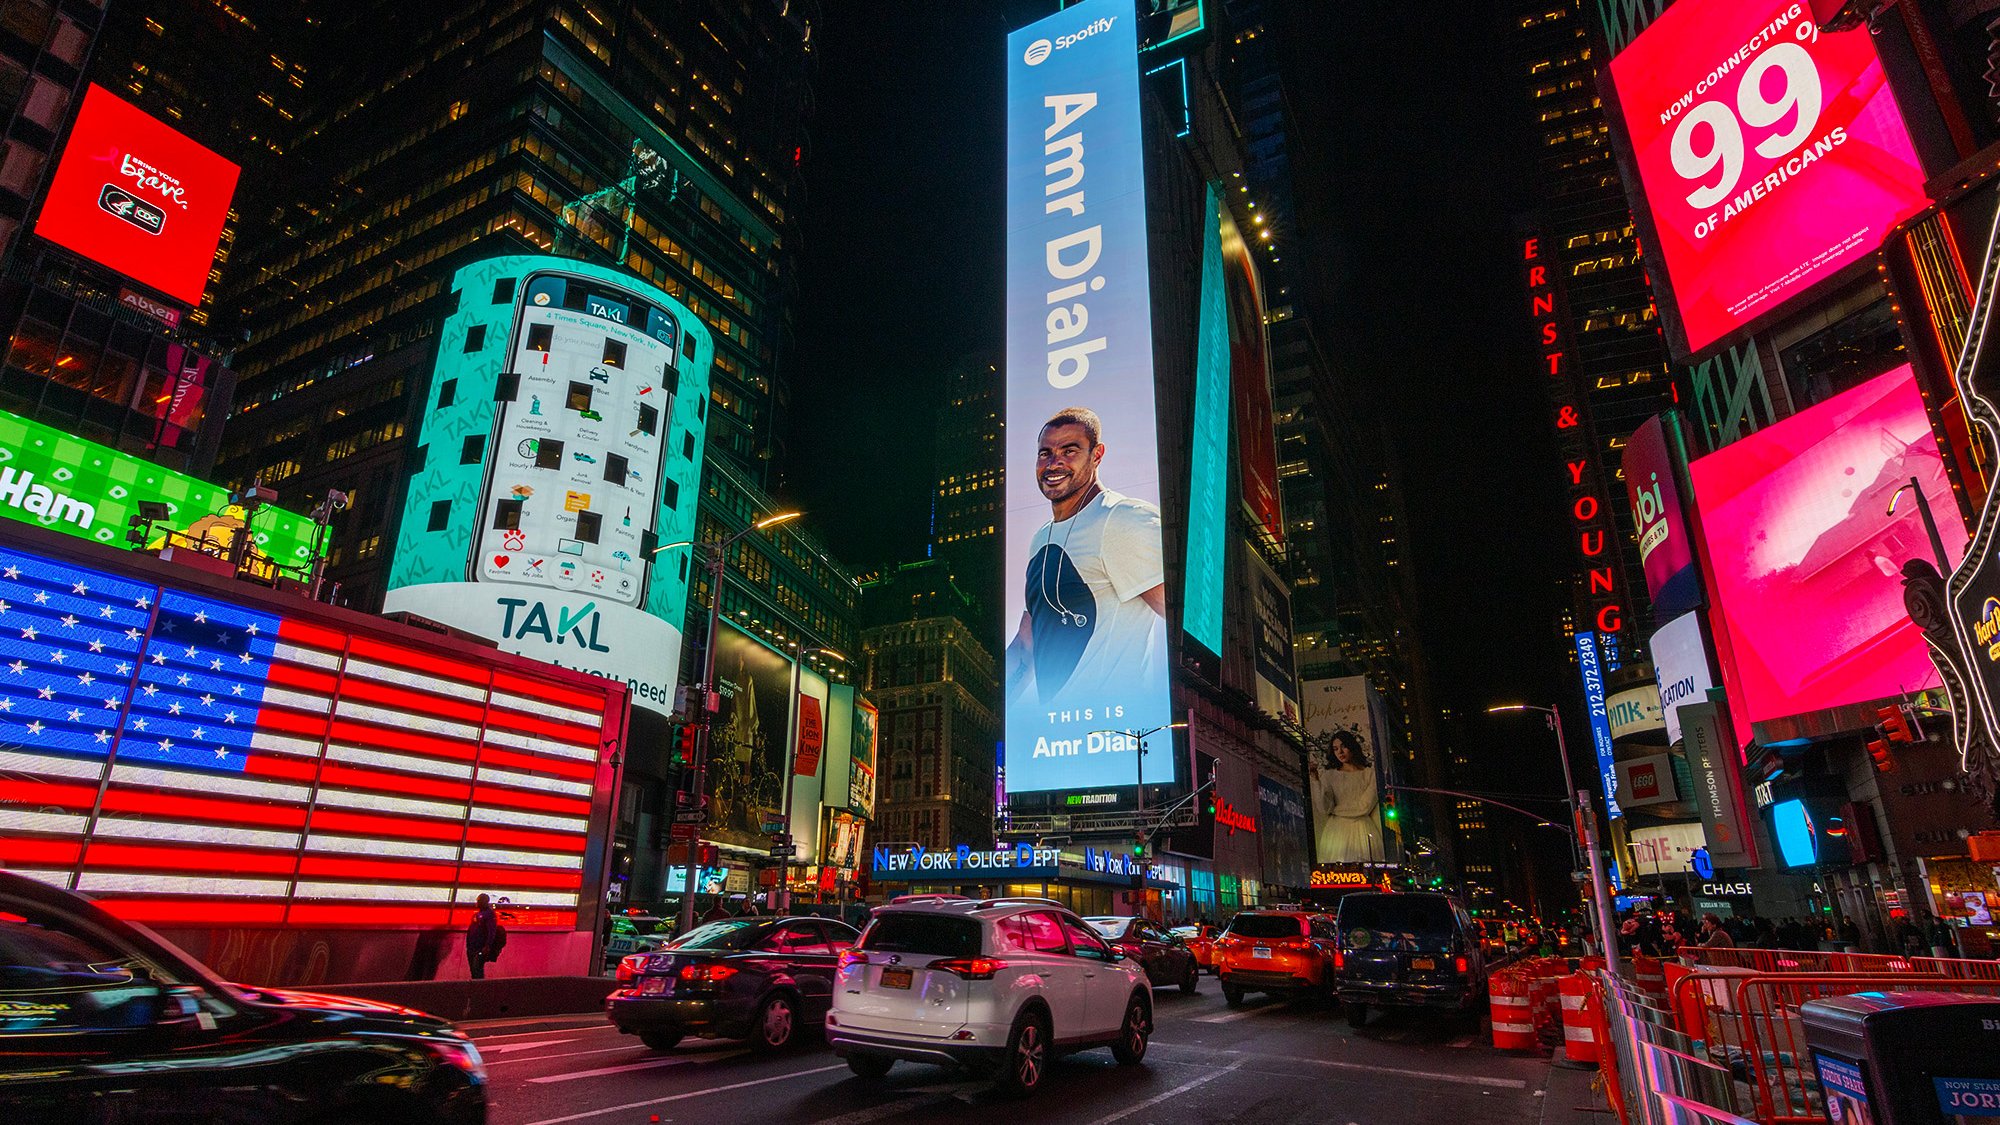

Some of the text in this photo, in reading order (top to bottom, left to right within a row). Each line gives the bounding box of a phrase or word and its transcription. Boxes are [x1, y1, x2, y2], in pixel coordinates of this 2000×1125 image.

[1055, 16, 1118, 50] Spotify
[1659, 2, 1803, 125] NOW CONNECTING
[132, 157, 180, 186] BRING YOUR
[1694, 126, 1848, 240] OF AMERICANS
[137, 209, 160, 225] CDC
[1044, 92, 1107, 390] Amr Diab
[1828, 243, 1841, 253] does
[1842, 236, 1851, 245] not
[123, 294, 175, 322] Absen
[591, 302, 623, 324] TAKL
[553, 312, 577, 324] Times
[579, 317, 609, 332] Square,
[611, 326, 629, 339] New
[647, 341, 658, 350] NY
[528, 375, 556, 384] Assembly
[521, 418, 543, 427] Cleaning
[579, 427, 598, 436] Delivery
[1524, 237, 1563, 376] ERNST
[1556, 405, 1578, 429] &
[1567, 461, 1621, 634] YOUNG
[0, 466, 96, 529] Ham
[615, 528, 635, 539] Painting
[497, 597, 610, 653] TAKL
[1974, 611, 1997, 646] Hard
[1579, 637, 1607, 717] 212.372.2349
[627, 677, 668, 706] need
[805, 718, 816, 728] THE
[1048, 705, 1125, 724] THIS IS
[802, 727, 819, 741] LION
[1032, 728, 1139, 759] Amr Diab
[800, 740, 820, 757] KING
[1633, 773, 1654, 788] LEGO
[1706, 774, 1722, 819] THOMSON
[1754, 781, 1774, 809] AT&T
[1215, 797, 1257, 836] Walgreens
[873, 842, 1061, 872] NEW YORK POLICE DEPT
[1085, 845, 1105, 872] NEW
[1103, 850, 1123, 875] YORK
[1311, 870, 1367, 884] Subway
[1703, 883, 1752, 895] CHASE
[1944, 1081, 2000, 1091] NOW STAR
